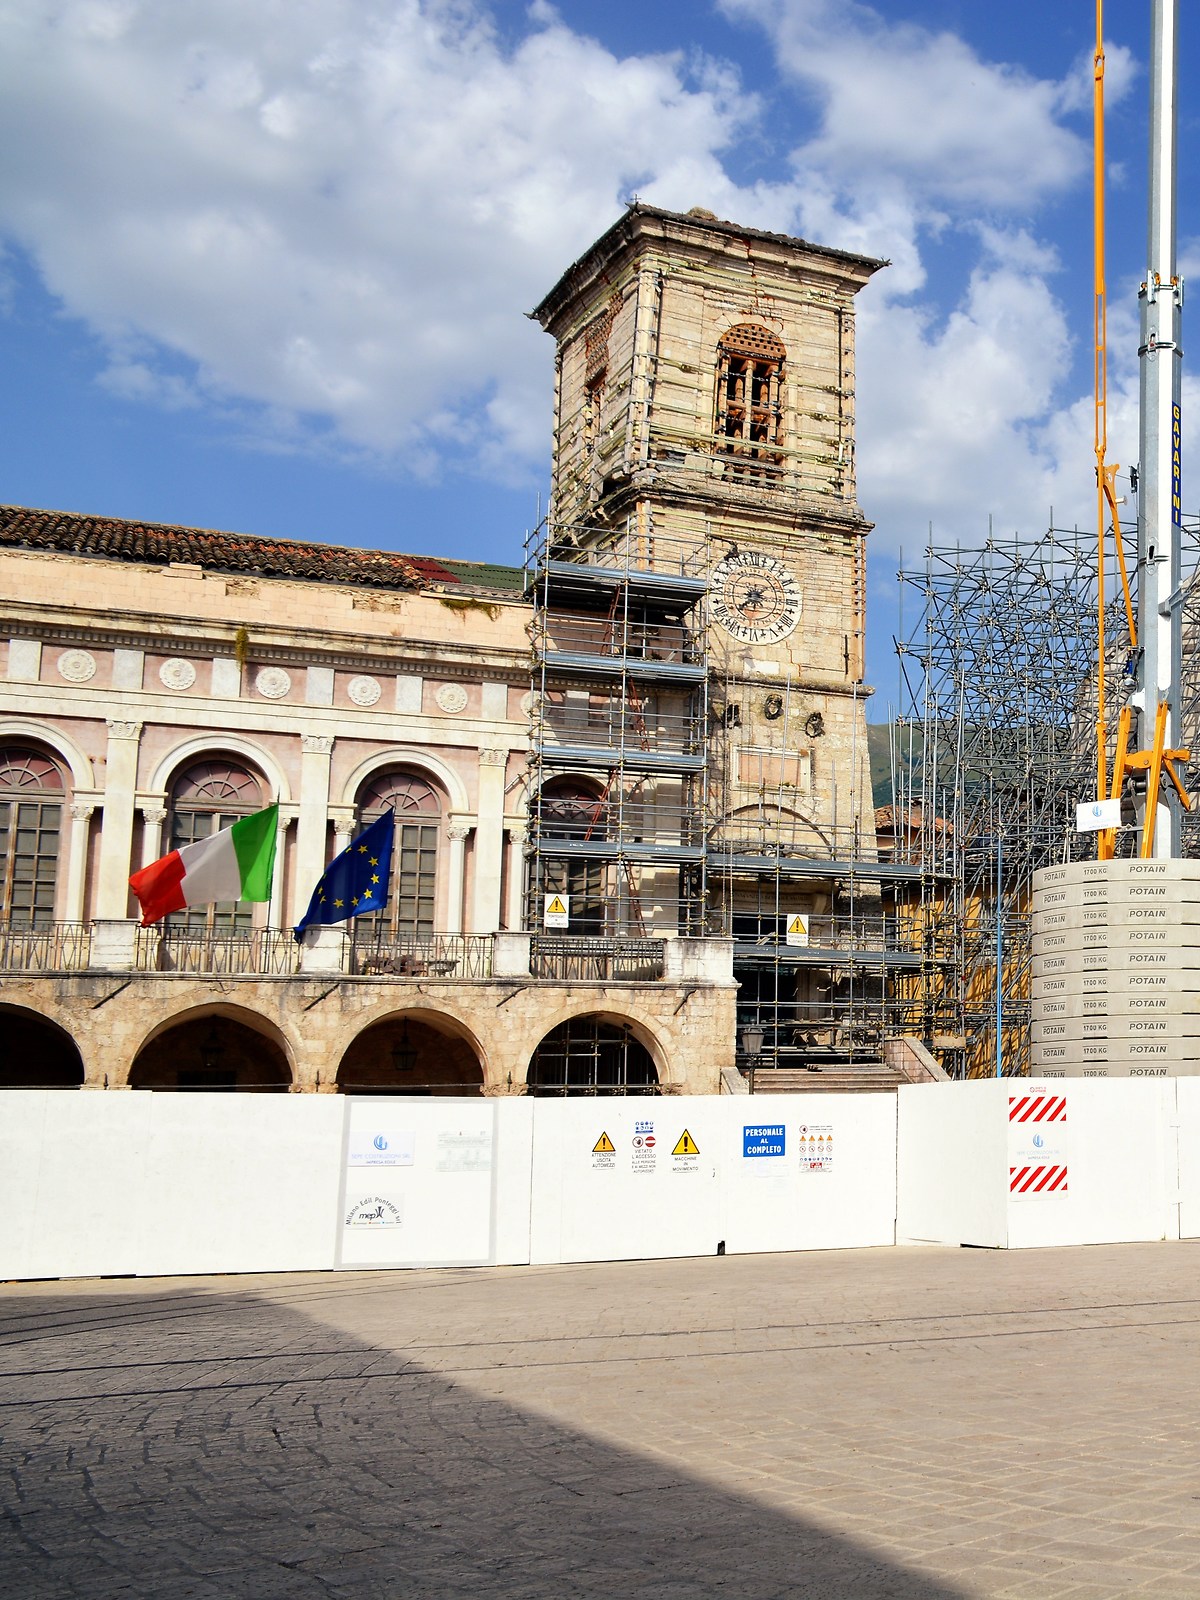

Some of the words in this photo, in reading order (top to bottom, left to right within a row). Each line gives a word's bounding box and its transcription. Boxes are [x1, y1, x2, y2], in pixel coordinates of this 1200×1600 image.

[1044, 872, 1065, 881] POTAIN
[1044, 894, 1065, 903] POTAIN
[1044, 916, 1065, 925] POTAIN
[1044, 938, 1065, 947] POTAIN
[1129, 932, 1166, 940] POTAIN
[1043, 960, 1065, 969] POTAIN
[1043, 982, 1065, 990] POTAIN
[1129, 977, 1166, 985] POTAIN
[1043, 1004, 1065, 1013] POTAIN
[1043, 1026, 1065, 1035] POTAIN
[1129, 1022, 1166, 1030] POTAIN
[1043, 1049, 1065, 1057] POTAIN
[1130, 1068, 1167, 1076] POTAIN
[745, 1128, 783, 1136] PERSONALE
[747, 1145, 782, 1154] COMPLETO
[346, 1205, 359, 1225] Milano
[360, 1197, 373, 1206] Edil
[374, 1196, 400, 1214] Ponteggi
